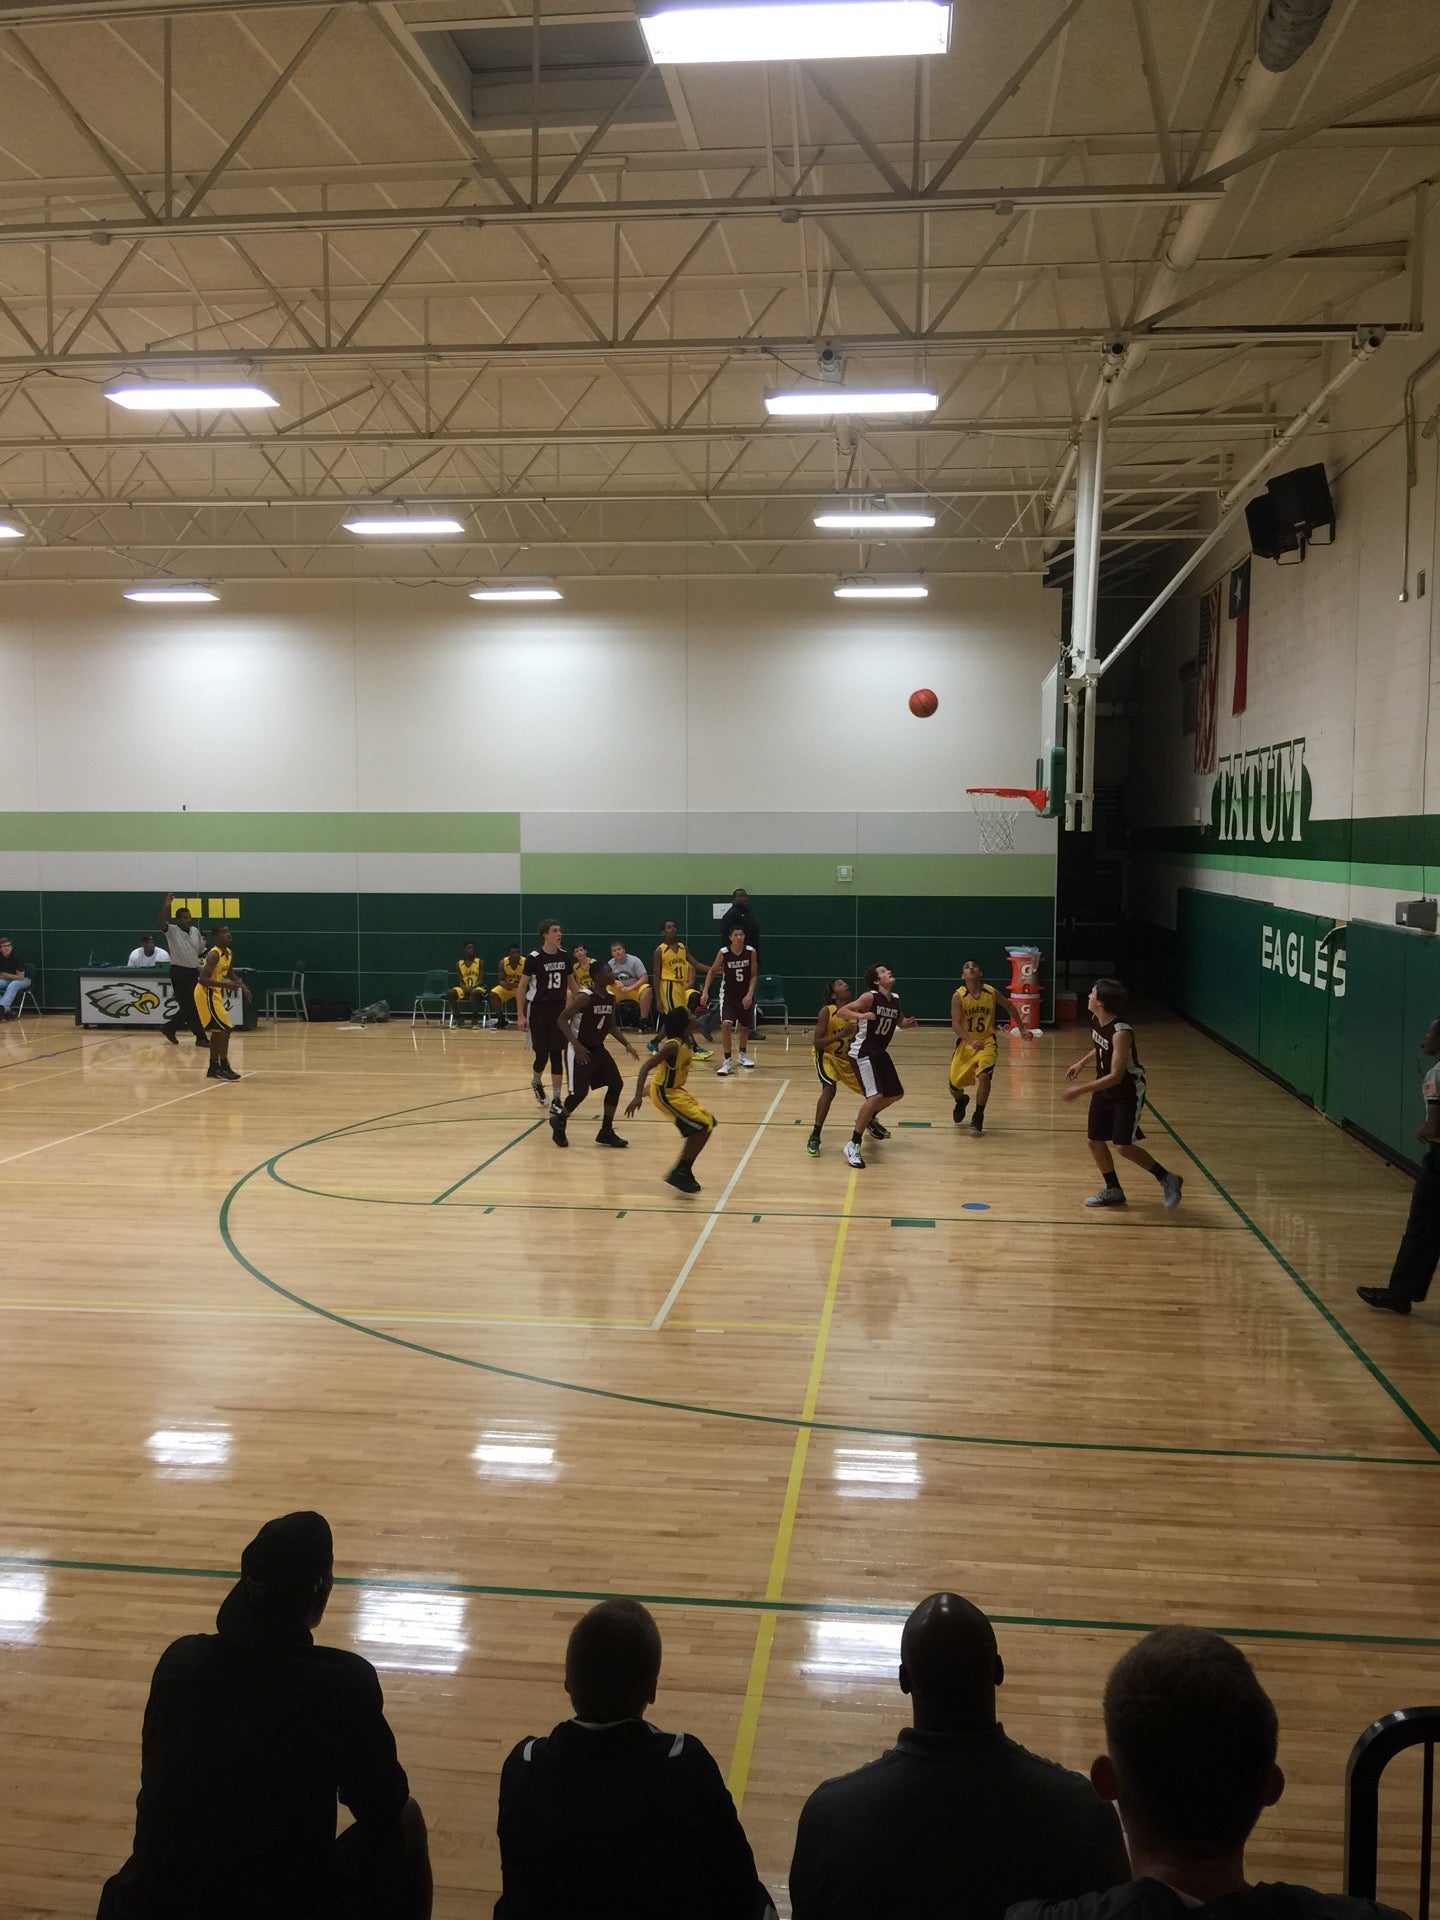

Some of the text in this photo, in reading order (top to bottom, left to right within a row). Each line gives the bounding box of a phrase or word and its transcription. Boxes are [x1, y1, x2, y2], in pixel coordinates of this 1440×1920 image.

[1217, 738, 1306, 843] TATUM
[543, 961, 566, 972] WILDCATS
[727, 959, 750, 969] WILDCATS
[1261, 924, 1347, 998] EAGLES
[673, 966, 684, 980] 11
[735, 968, 744, 982] 5
[1021, 964, 1033, 976] G
[547, 972, 562, 989] 13
[876, 1005, 899, 1019] WILDCATS
[1020, 1004, 1031, 1015] G
[874, 1016, 893, 1036] 10
[966, 1016, 986, 1033] 15
